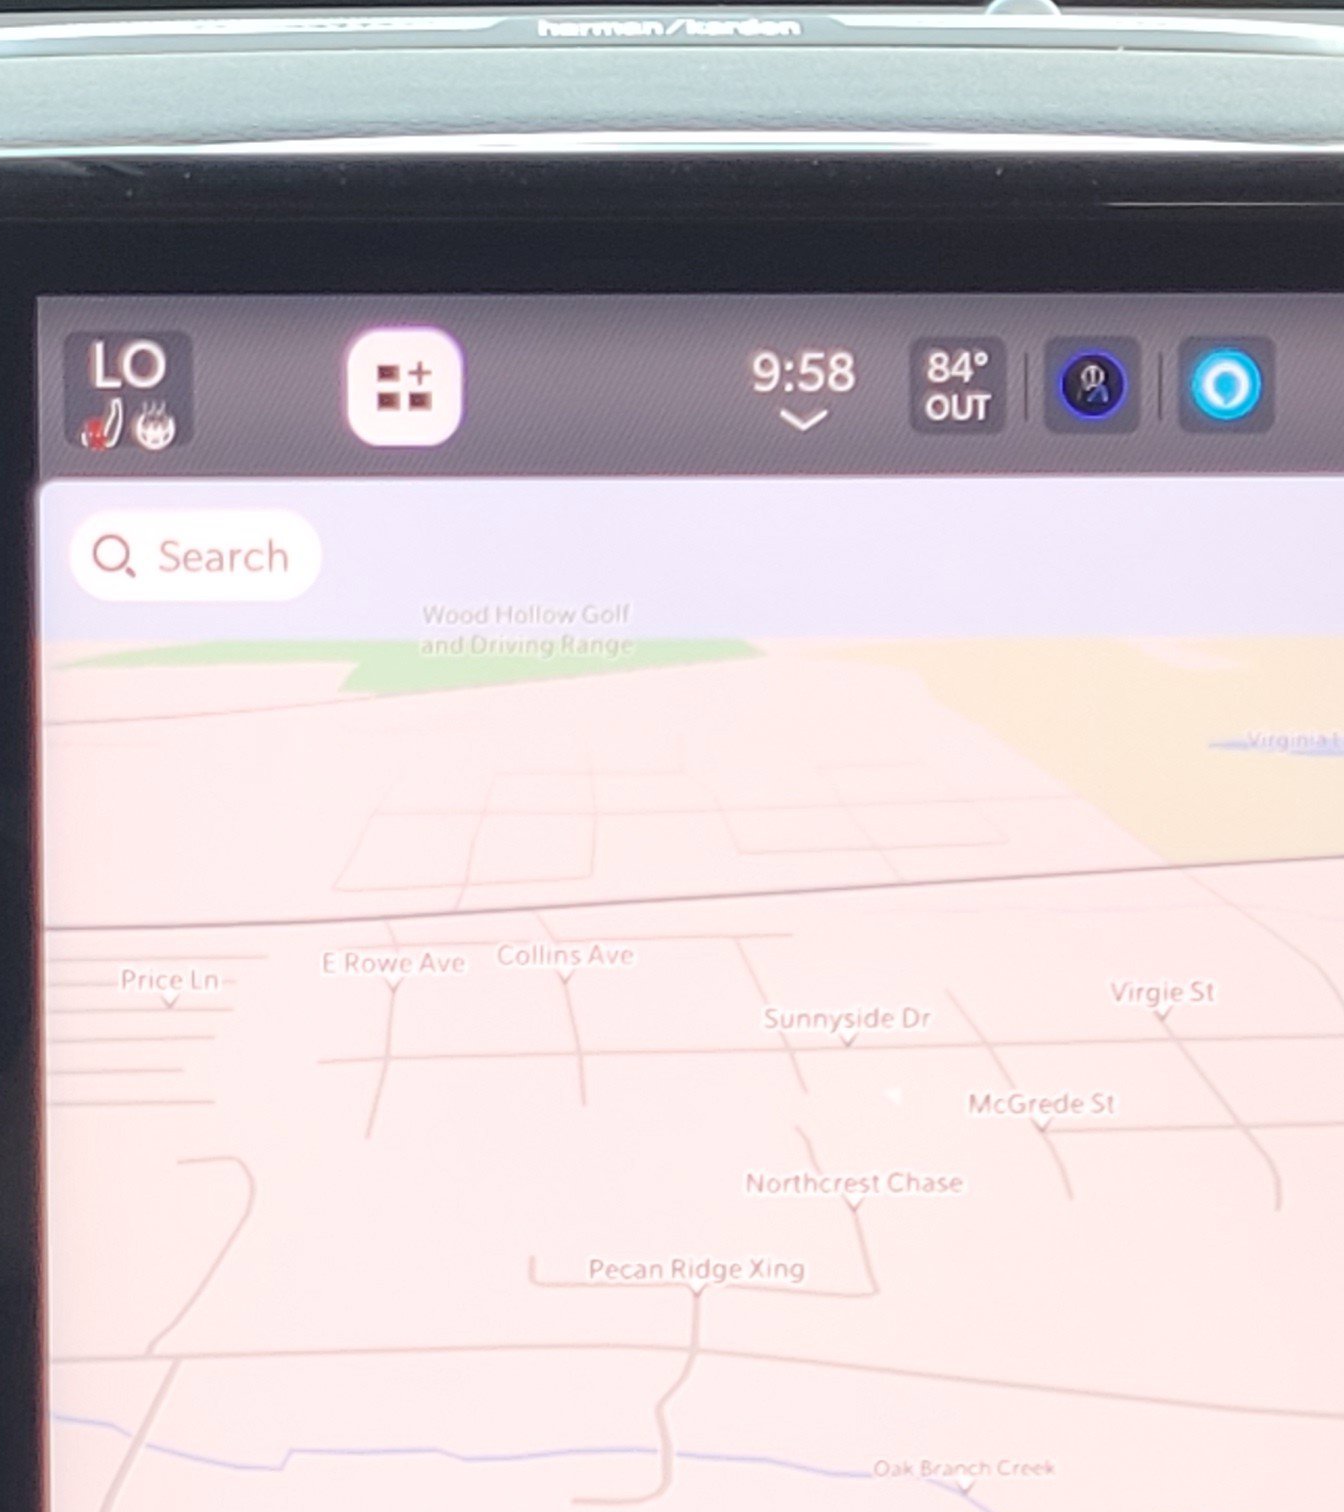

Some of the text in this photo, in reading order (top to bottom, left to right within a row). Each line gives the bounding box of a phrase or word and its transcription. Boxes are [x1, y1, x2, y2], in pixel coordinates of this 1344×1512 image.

[90, 340, 167, 390] LO
[751, 350, 856, 393] 9:58
[926, 349, 990, 385] 84°
[925, 393, 991, 422] OUT
[158, 538, 289, 575] Search
[422, 603, 632, 624] Wood Hollow Golf
[421, 635, 634, 659] and Driving Range
[1247, 732, 1327, 750] Virginia
[322, 952, 466, 974] E Rowe Ave
[497, 944, 635, 966] Collins Ave
[121, 969, 220, 991] Price Ln
[1110, 981, 1216, 1009] Virgie St
[763, 1008, 932, 1035] Sunnyside Dr
[968, 1094, 1116, 1115] McGrede St
[746, 1172, 964, 1194] Northcrest Chase
[589, 1258, 805, 1284] Pecan Ridge Xing
[873, 1459, 1056, 1477] Oak Branch Creek
